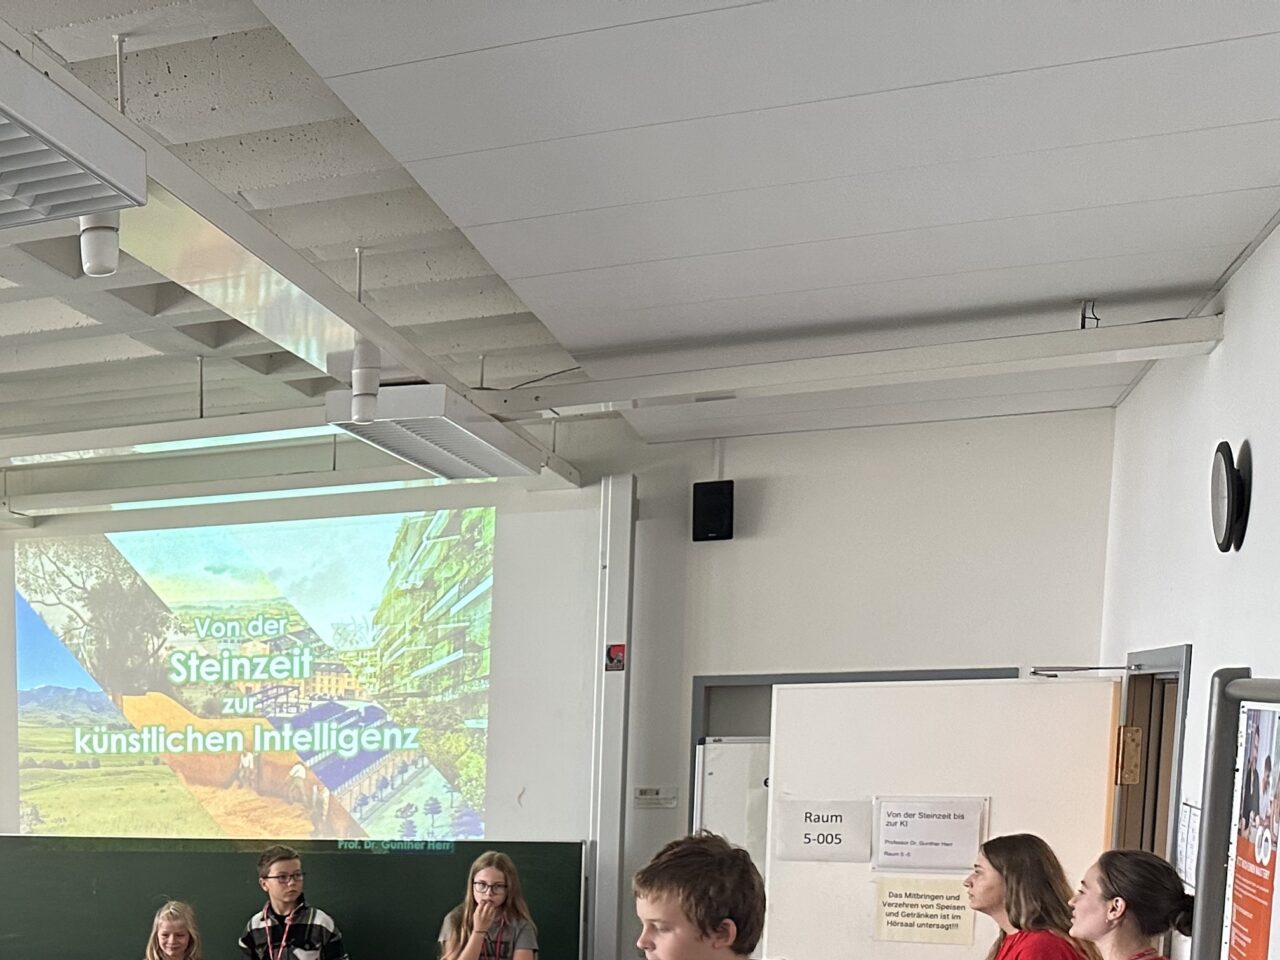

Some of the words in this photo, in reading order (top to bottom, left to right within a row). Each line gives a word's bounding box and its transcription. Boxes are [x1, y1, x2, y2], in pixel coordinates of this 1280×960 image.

[194, 617, 241, 639] Von
[248, 614, 288, 636] der
[169, 647, 313, 683] Steinzeit
[222, 695, 256, 715] zur
[74, 726, 244, 754] künstlichen
[253, 723, 419, 758] Intelligenz
[804, 812, 842, 823] Raum
[918, 812, 952, 820] Steinzeit
[803, 833, 842, 845] 5-005
[337, 840, 361, 850] Prof.
[364, 840, 379, 850] Dr.
[427, 840, 451, 850] Herr
[888, 891, 903, 899] Das
[904, 892, 944, 901] Mitbringen
[946, 893, 960, 901] und
[882, 901, 919, 909] Verzehren
[936, 903, 966, 912] Speisen
[901, 911, 939, 919] Getränken
[886, 920, 915, 928] Hörsaal
[916, 921, 959, 930] untersagt!!!
